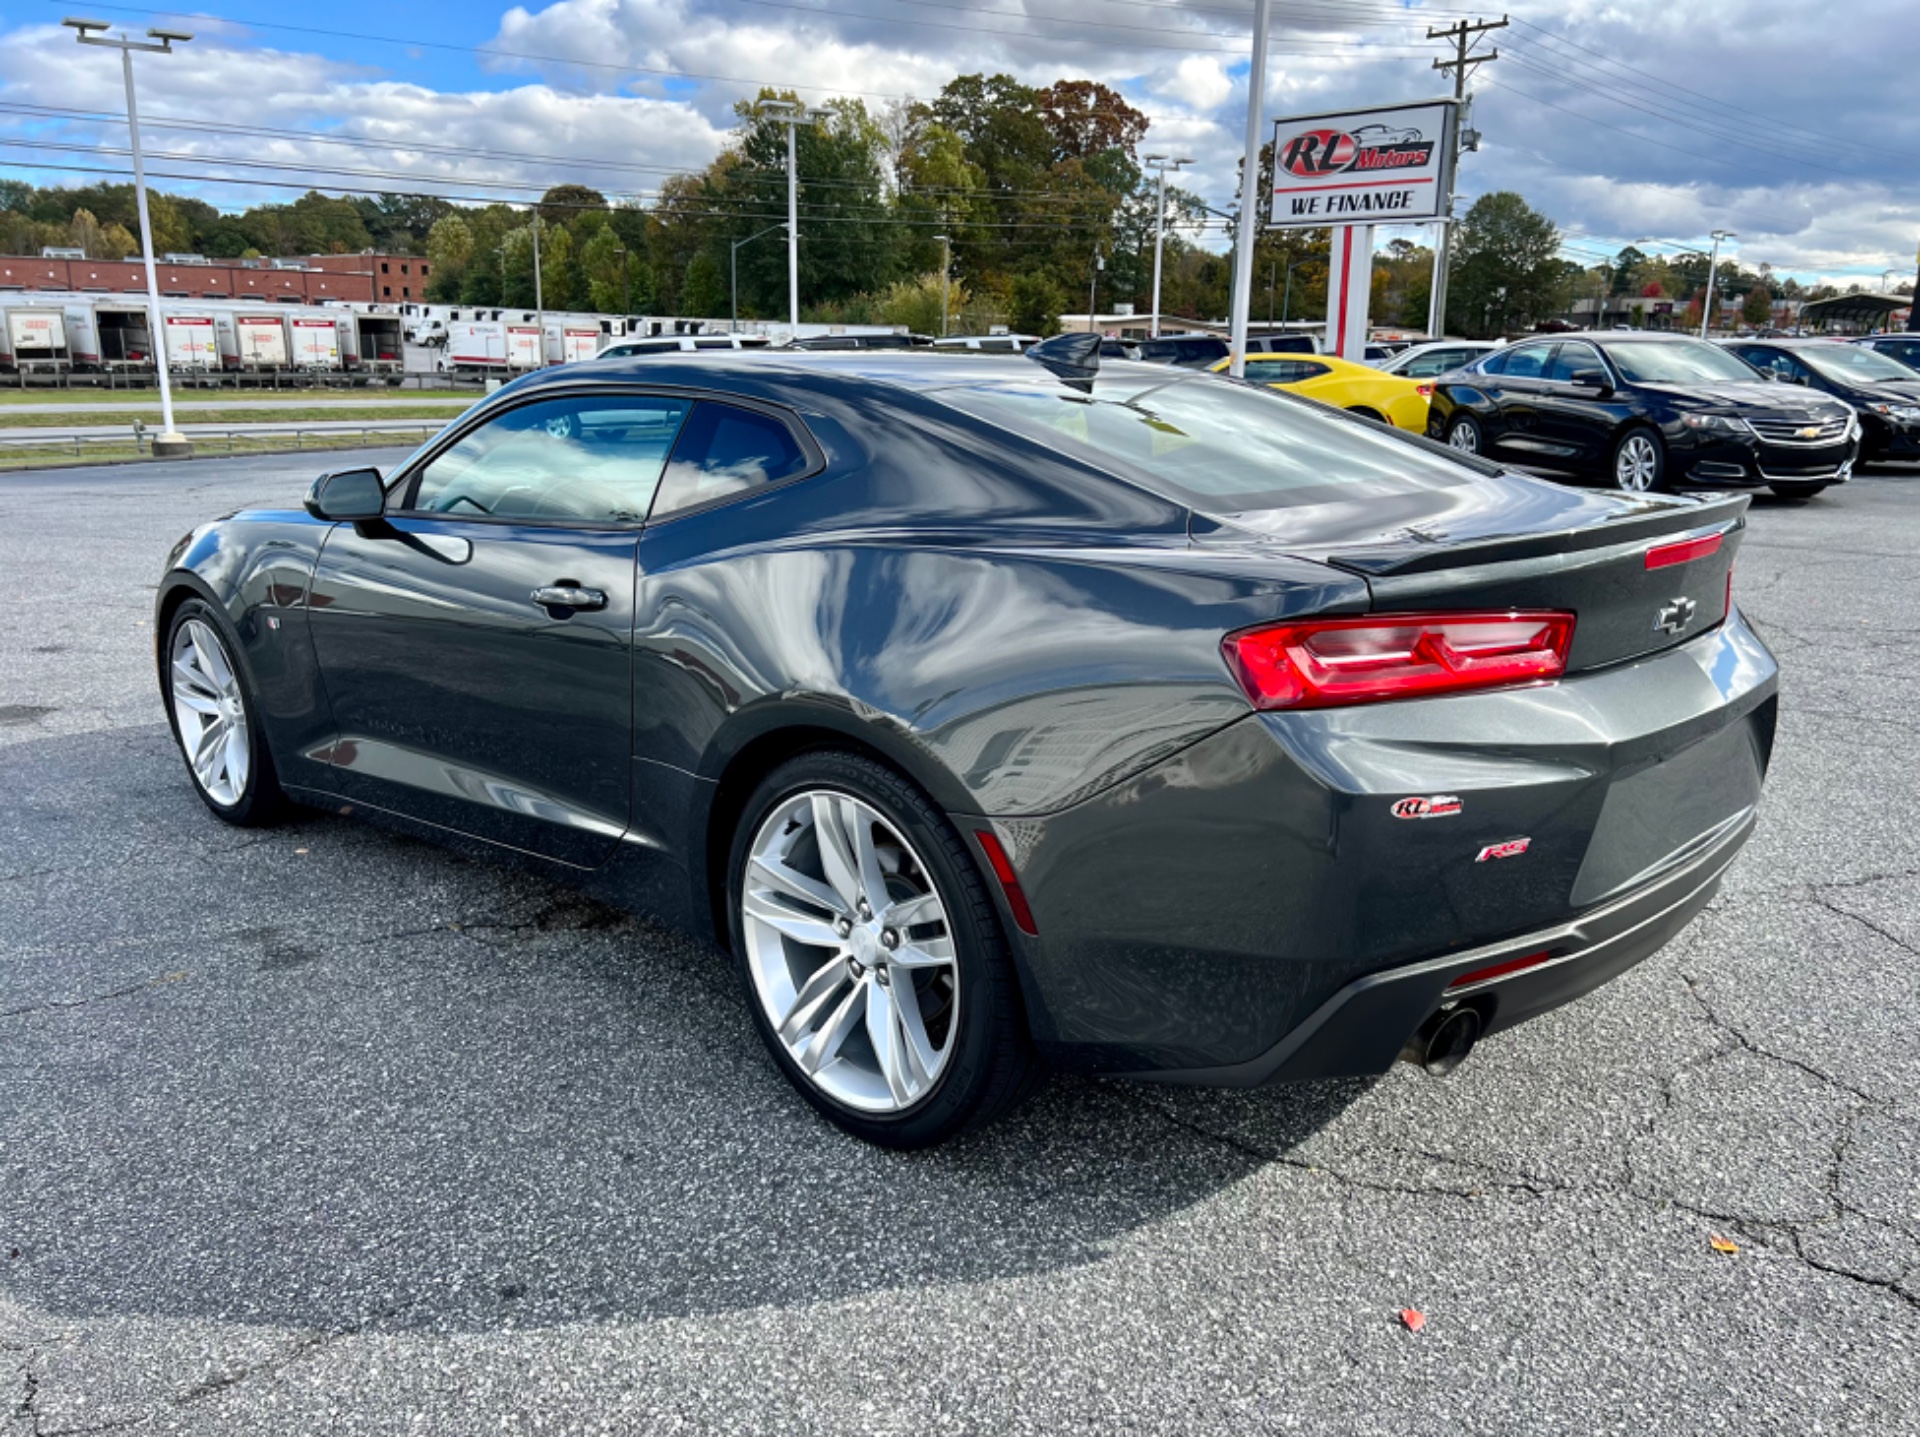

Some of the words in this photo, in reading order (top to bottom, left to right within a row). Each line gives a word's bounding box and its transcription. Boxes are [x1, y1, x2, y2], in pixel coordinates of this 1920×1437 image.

[1284, 133, 1347, 173] RL
[1355, 147, 1429, 170] Motors
[1291, 196, 1321, 215] WE
[1325, 190, 1415, 214] FINANCE
[1396, 800, 1428, 816] RL
[1475, 837, 1532, 862] RS
